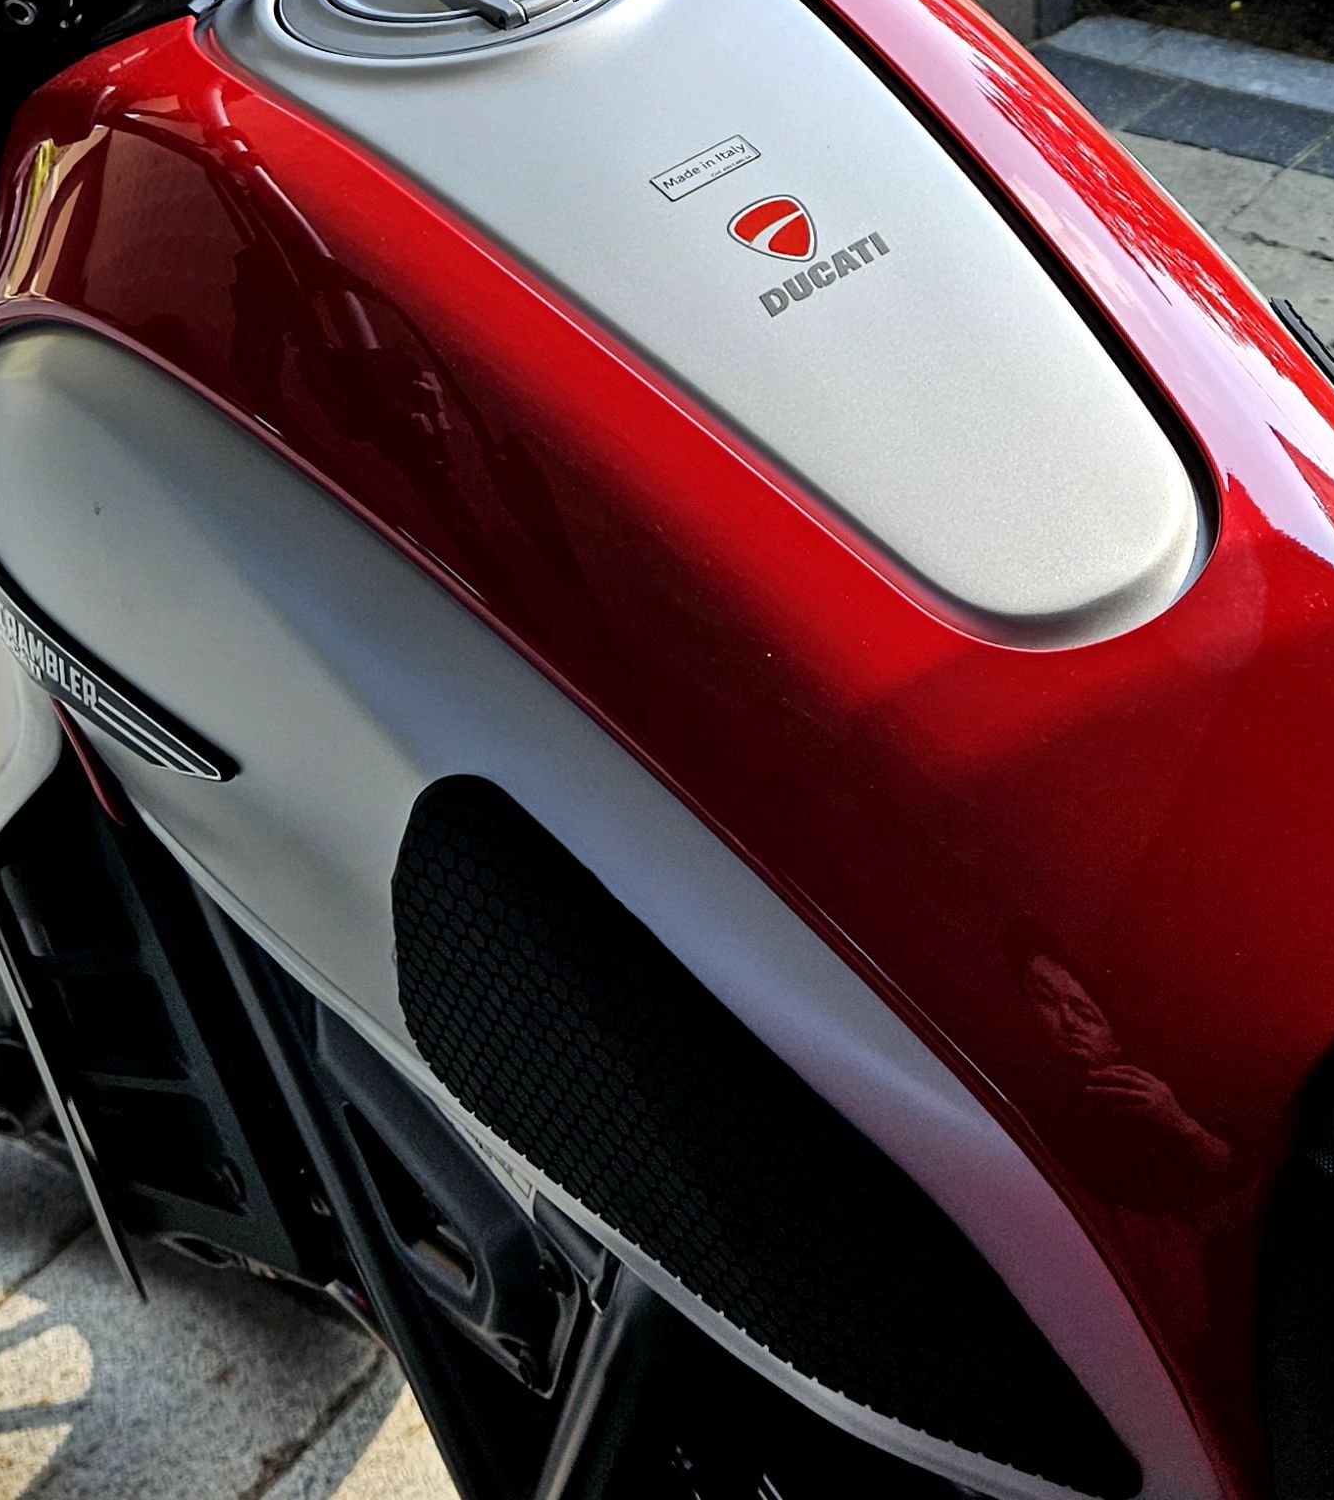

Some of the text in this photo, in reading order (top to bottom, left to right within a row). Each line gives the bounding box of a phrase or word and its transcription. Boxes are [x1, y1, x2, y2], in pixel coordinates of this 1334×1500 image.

[662, 165, 700, 190] Made
[701, 157, 716, 171] in
[716, 142, 747, 163] Italy
[759, 231, 890, 318] DUCATI
